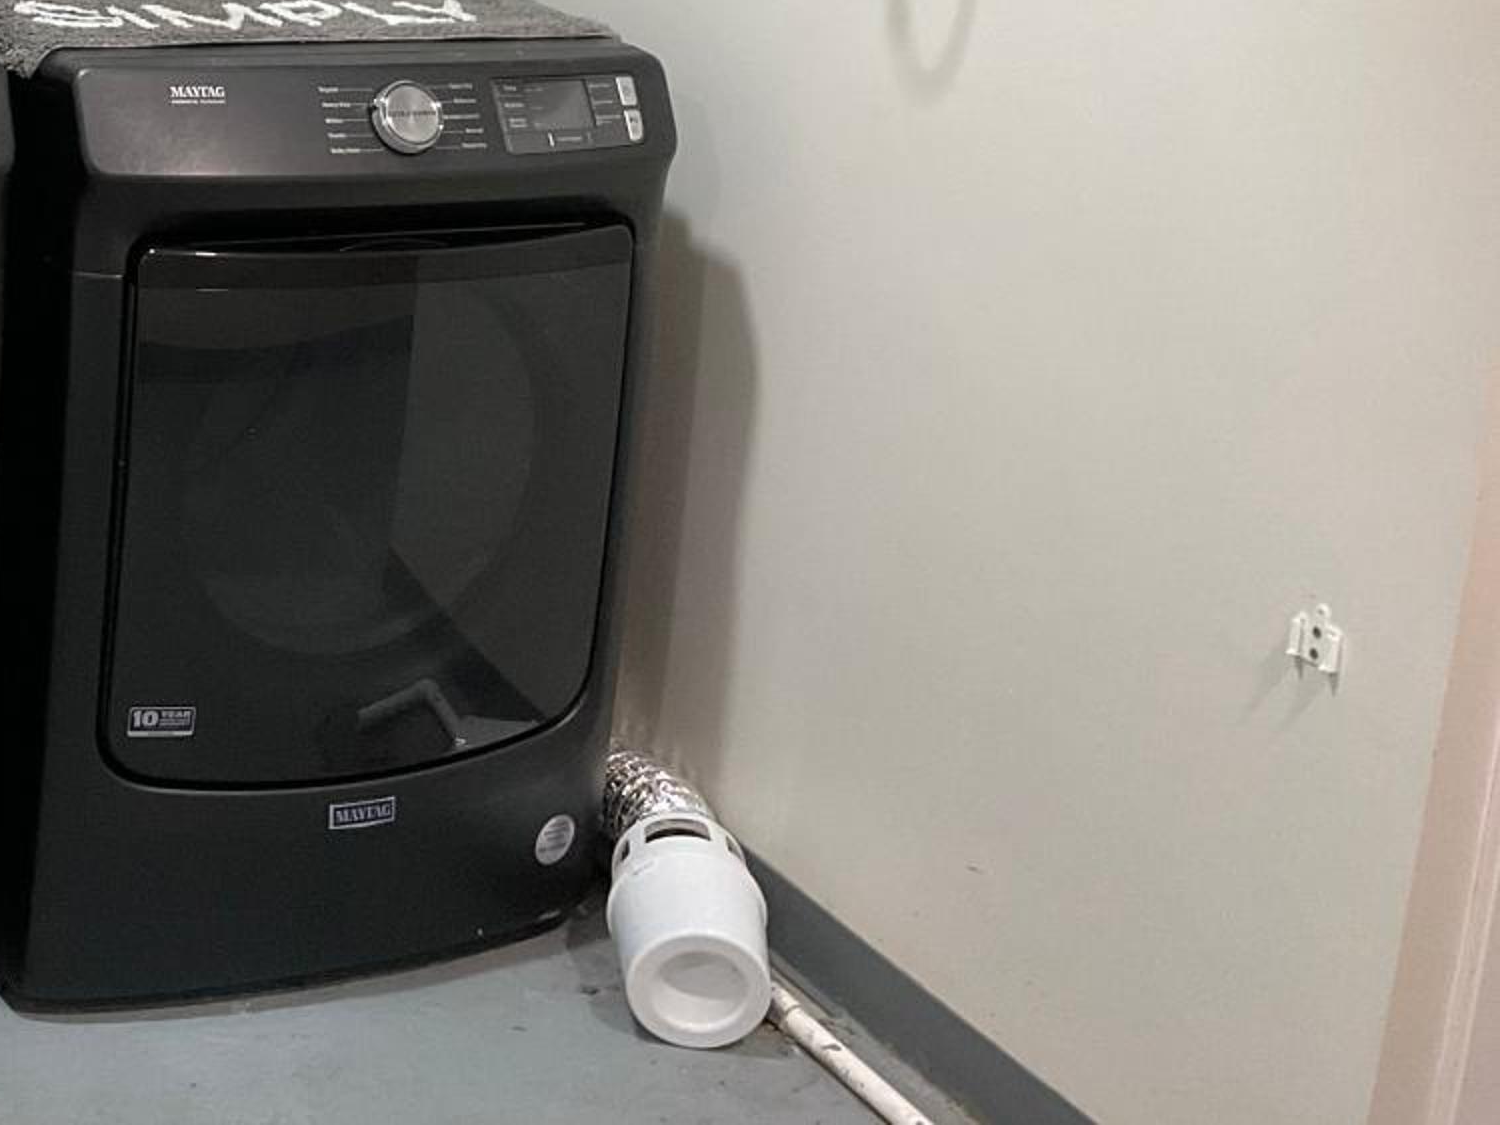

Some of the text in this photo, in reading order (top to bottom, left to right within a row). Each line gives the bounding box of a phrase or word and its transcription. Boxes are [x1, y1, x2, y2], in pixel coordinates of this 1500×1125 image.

[169, 85, 226, 98] MAYTAG
[132, 709, 160, 729] 10
[335, 803, 391, 824] MAYTAG
